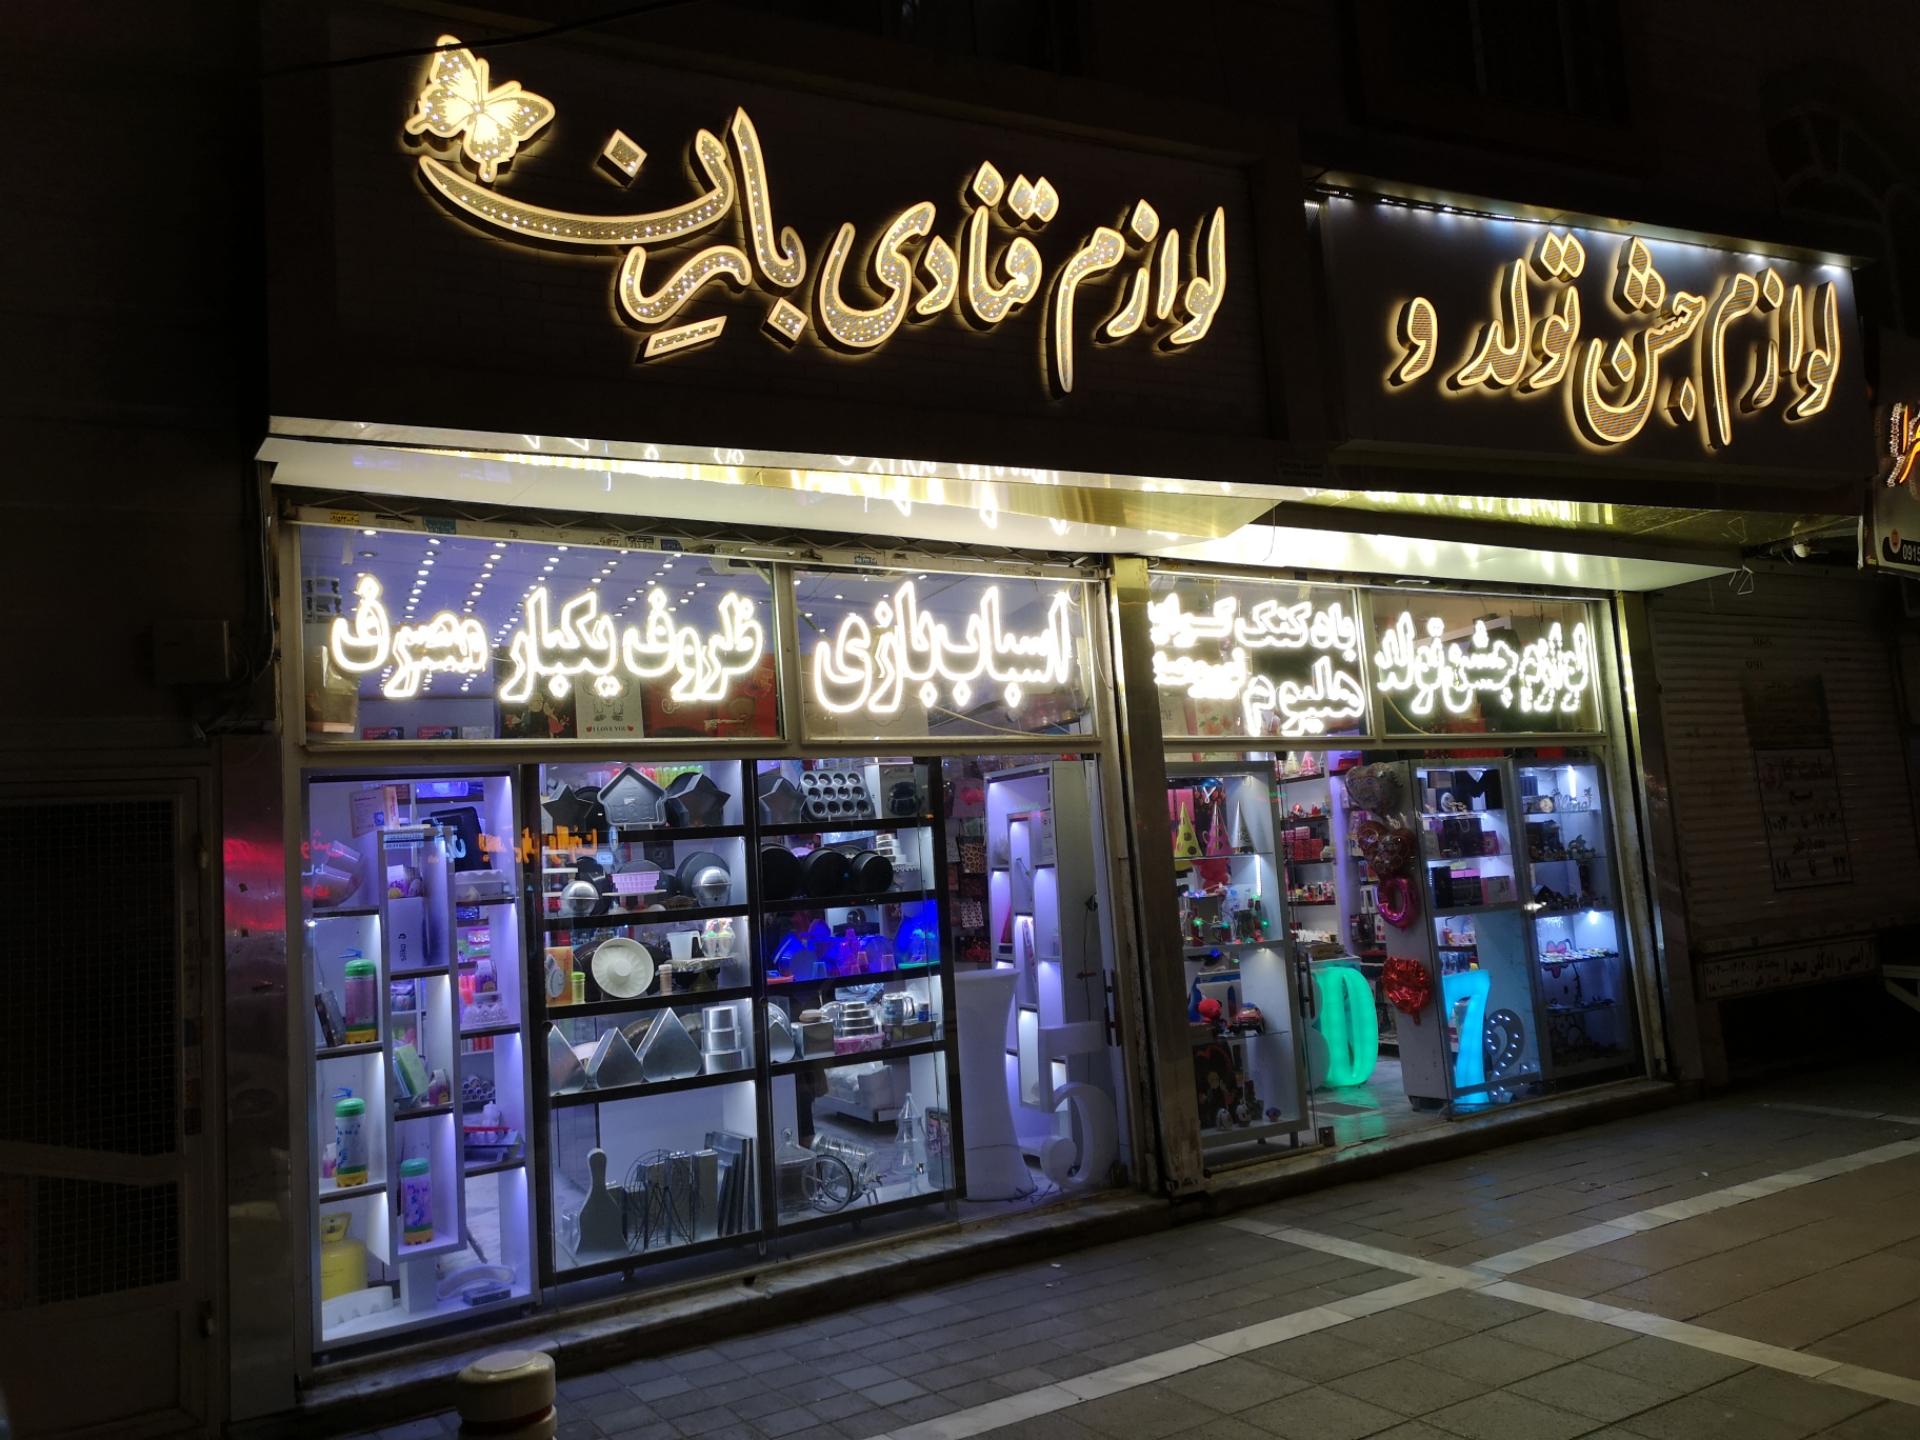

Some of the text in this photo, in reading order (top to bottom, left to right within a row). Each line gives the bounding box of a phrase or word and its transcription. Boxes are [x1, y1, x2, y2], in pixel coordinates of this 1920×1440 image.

[818, 160, 1060, 348] قنادی
[1053, 198, 1226, 392] لوازم
[1393, 231, 1840, 445] لوازم جشن تولد و
[331, 576, 763, 702] ظروف یکبار مصرف
[813, 579, 938, 714] بازی
[938, 585, 1074, 709] اسباب
[1242, 655, 1366, 738] هلیوم
[1374, 611, 1589, 714] لوازم جشن تولد
